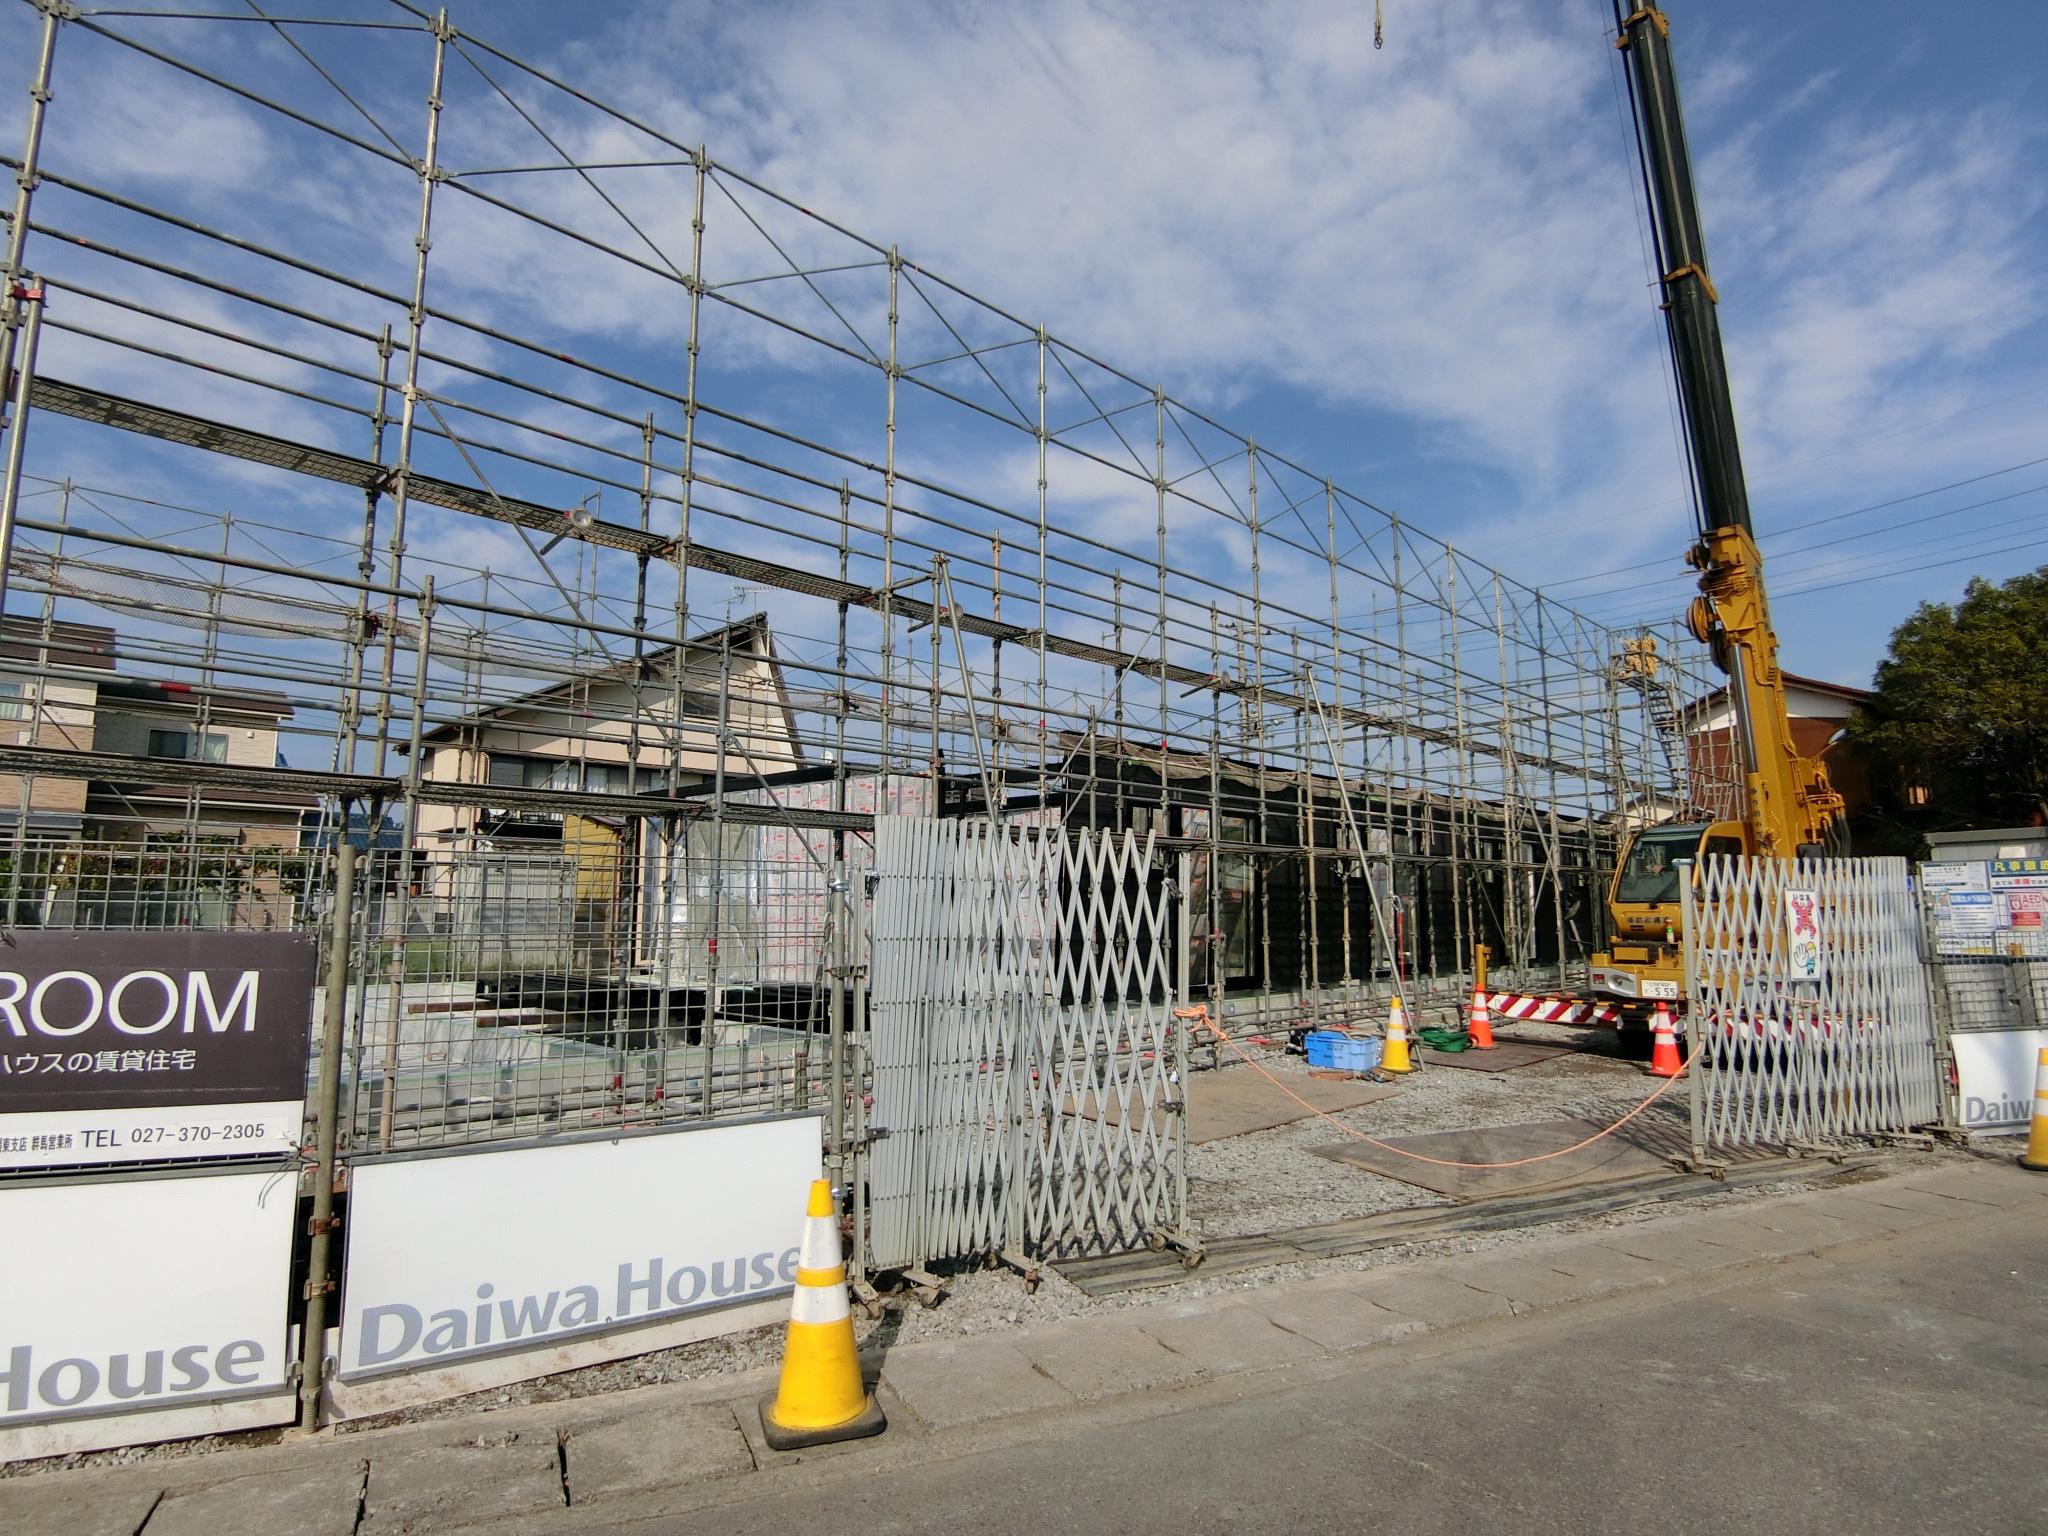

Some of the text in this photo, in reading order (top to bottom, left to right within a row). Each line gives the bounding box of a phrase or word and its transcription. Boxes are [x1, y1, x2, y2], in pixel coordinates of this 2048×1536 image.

[1965, 1092, 2030, 1123] Daiw
[0, 1135, 28, 1153] 東支店
[80, 1129, 122, 1148] TEL
[131, 1123, 265, 1143] 027-370-2305
[358, 1246, 801, 1366] Daiwa House
